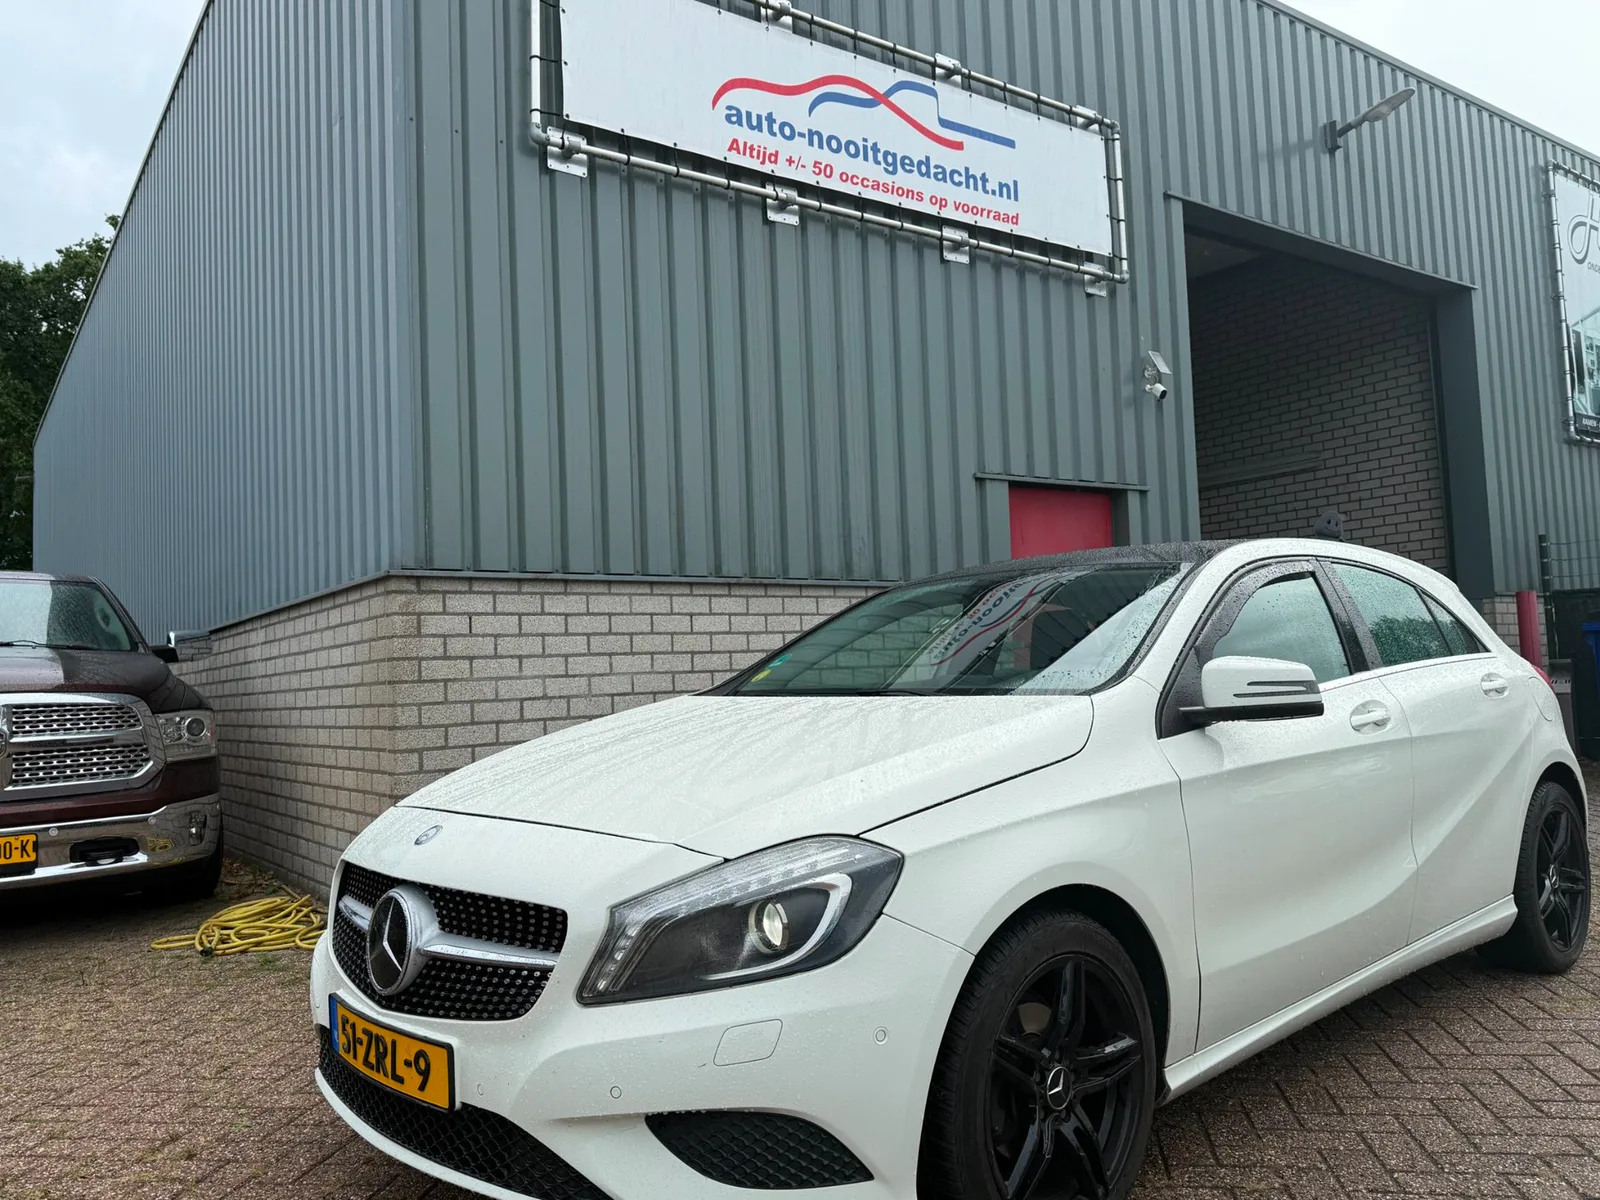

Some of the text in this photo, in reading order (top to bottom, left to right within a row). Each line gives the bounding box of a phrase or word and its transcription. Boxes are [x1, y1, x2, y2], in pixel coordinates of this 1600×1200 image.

[724, 104, 1020, 202] auto-nooitgedacht.nl
[727, 137, 1020, 226] Altijd +/- 50 occasions op voorraad
[341, 1013, 431, 1092] 51-ZRL-9
